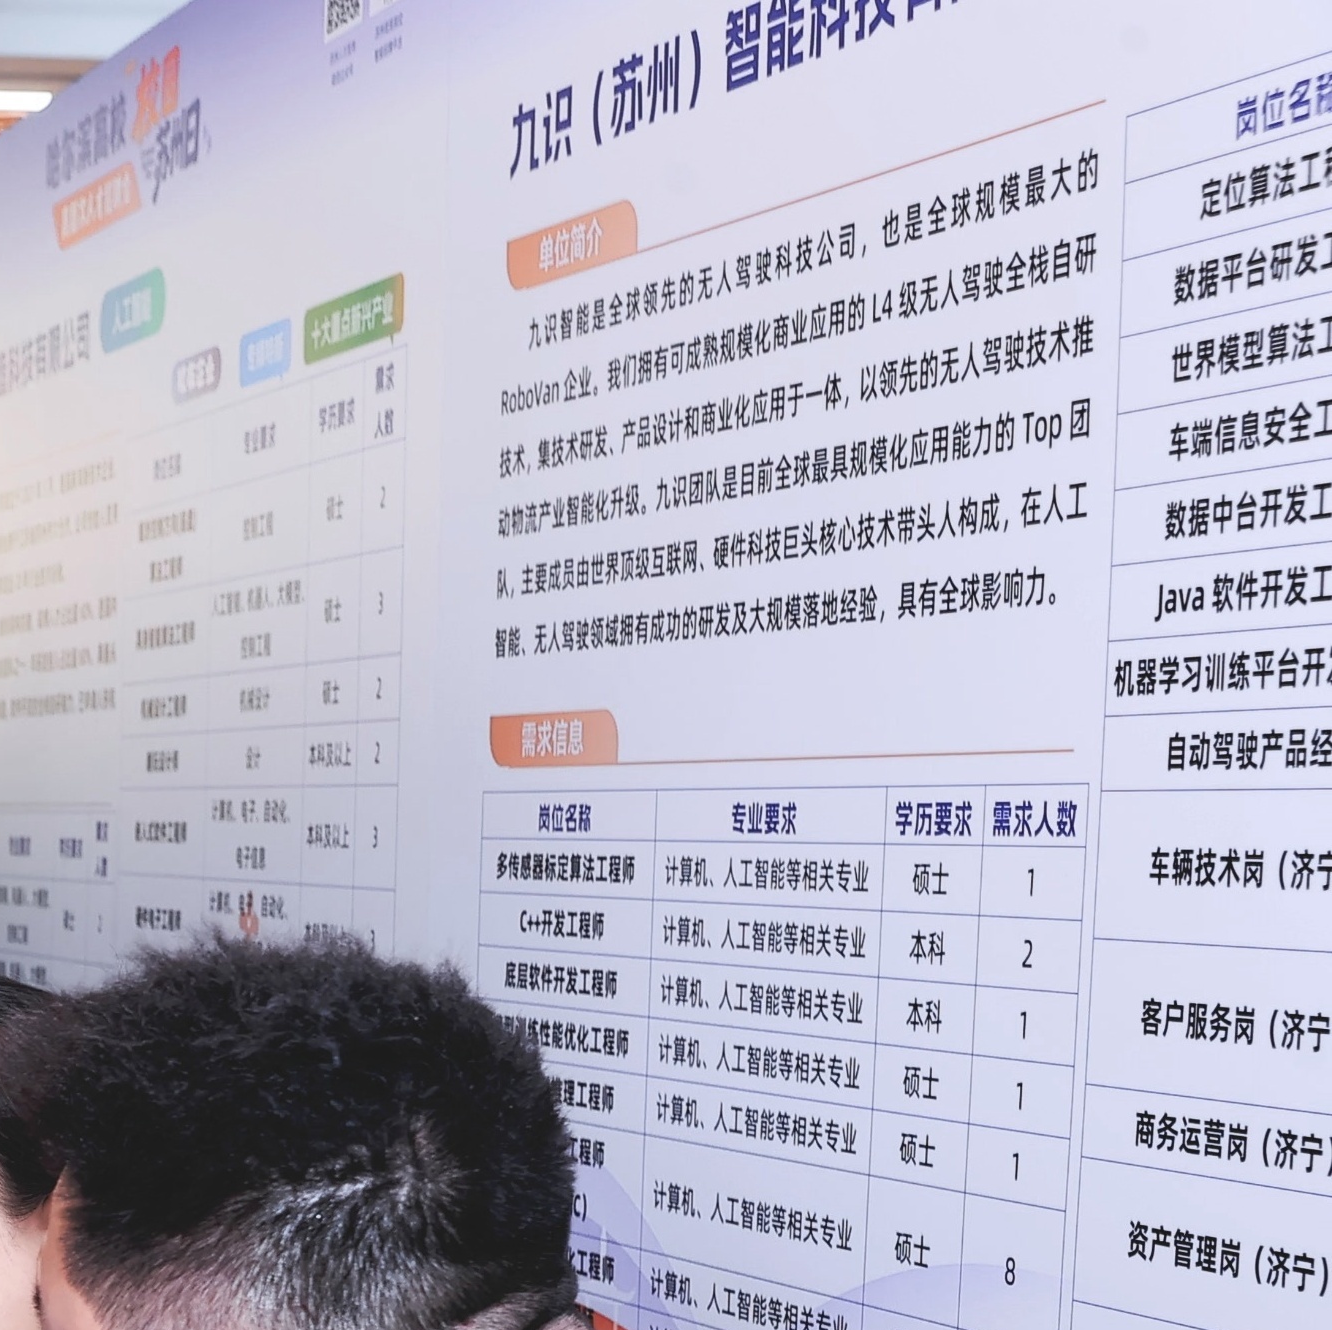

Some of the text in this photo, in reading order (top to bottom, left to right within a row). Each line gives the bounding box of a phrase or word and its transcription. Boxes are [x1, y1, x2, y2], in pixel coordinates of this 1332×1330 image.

[510, 0, 958, 180] 九识（苏州）智能科技
[528, 147, 1098, 350] 九识智能是全球领先的无人驾驶科技公司，也是全球规模最大的
[538, 217, 603, 273] 单位简介
[501, 379, 560, 415] RoboVan
[872, 289, 893, 323] L4
[898, 232, 1097, 319] 级无人驾驶全栈自研
[499, 314, 1094, 478] 技术，集技术研发、产品设计和商业化应用于一体，以领先的无人驾驶技术推
[1168, 398, 1332, 462] 车端信息安全工
[498, 398, 1091, 539] 动物流产业智能化升级。九识团队是目前全球最具规模化应用能力的 Top 团
[496, 482, 1087, 600] 队，主要成员由世界顶级互联网、硬件科技巨头核心技术带头人构成，在人工
[1164, 481, 1332, 541] 数据中台开发工
[495, 565, 1057, 659] 智能、无人驾驶领域拥有成功的研发及大规模落地经验，具有全球影响力。
[1154, 564, 1332, 623] Java 软件开发工
[1113, 636, 1332, 698] 机器学习训练平台开
[521, 718, 584, 758] 需求信息
[1166, 727, 1332, 772] 自动驾驶产品经
[537, 799, 1078, 838] 岗位名称 专业要求 学历要求 需求人数
[496, 851, 1036, 897] 多传感器标定算法工程师 计算机、人工智能等相关专业 硕士 1
[519, 909, 1033, 969] C++开发工程师 计算机、人工智能等相关专业 本科 2
[504, 961, 1028, 1040] 底层软件开发工程师 计算机、人工智能等相关专业 本科 1
[1140, 997, 1331, 1052] 客户服务岗（济宁
[495, 1013, 1024, 1111] 型训练性能优化工程师 计算机、人工智能等相关专业 硕士 1
[655, 1092, 857, 1155] 计算机、人工智能等相关专业
[899, 1132, 936, 1168] 硕士
[1012, 1152, 1020, 1181] 1
[652, 1180, 1016, 1286] 计算机、人工智能等相关专业 硕士 8
[1127, 1220, 1329, 1298] 资产管理岗（济宁）
